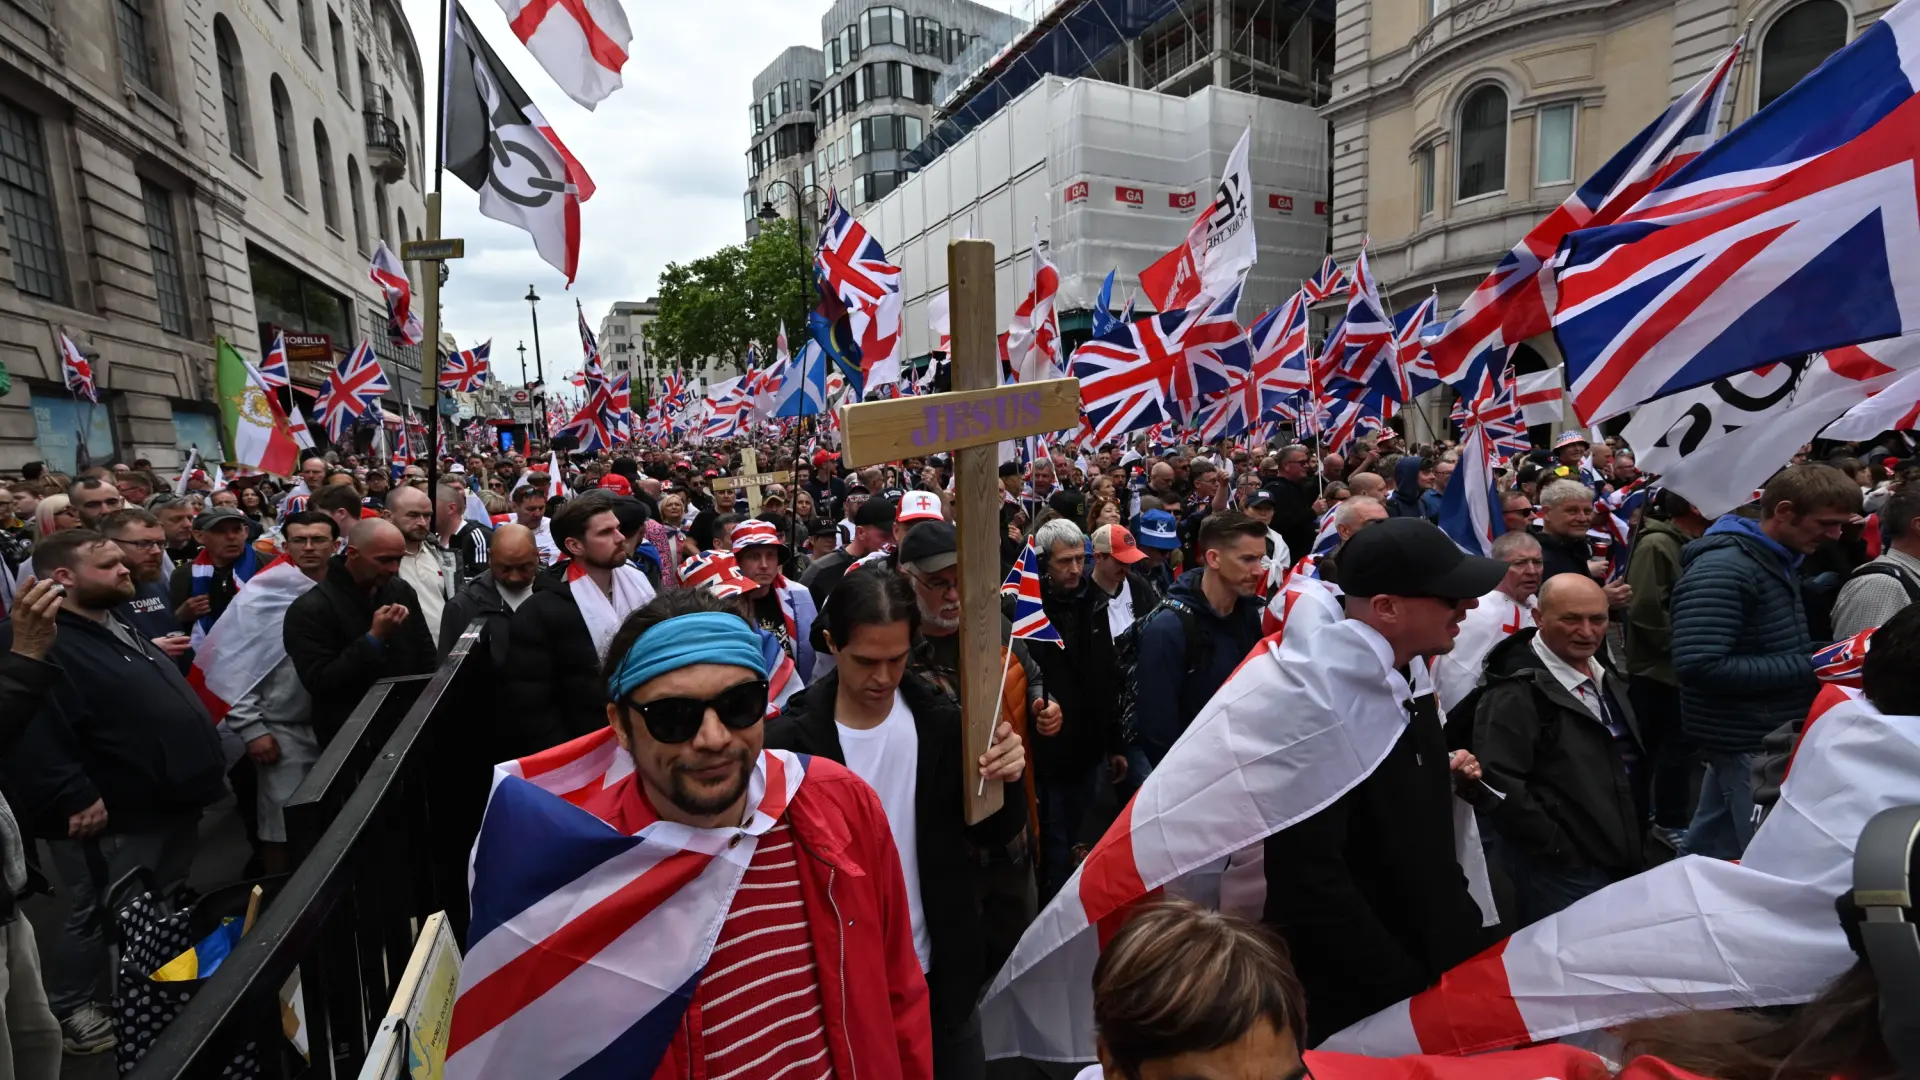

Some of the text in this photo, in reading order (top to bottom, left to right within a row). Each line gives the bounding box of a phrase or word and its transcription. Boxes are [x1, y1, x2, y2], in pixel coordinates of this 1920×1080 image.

[1072, 184, 1086, 197] GA
[1125, 190, 1142, 202] GA
[1178, 195, 1195, 207] GA
[1277, 197, 1292, 208] GA
[285, 336, 327, 345] TORTILLA
[911, 391, 1042, 446] JESUS
[728, 474, 774, 488] JESUS
[129, 596, 161, 609] TOMMY
[147, 603, 165, 612] JEANS
